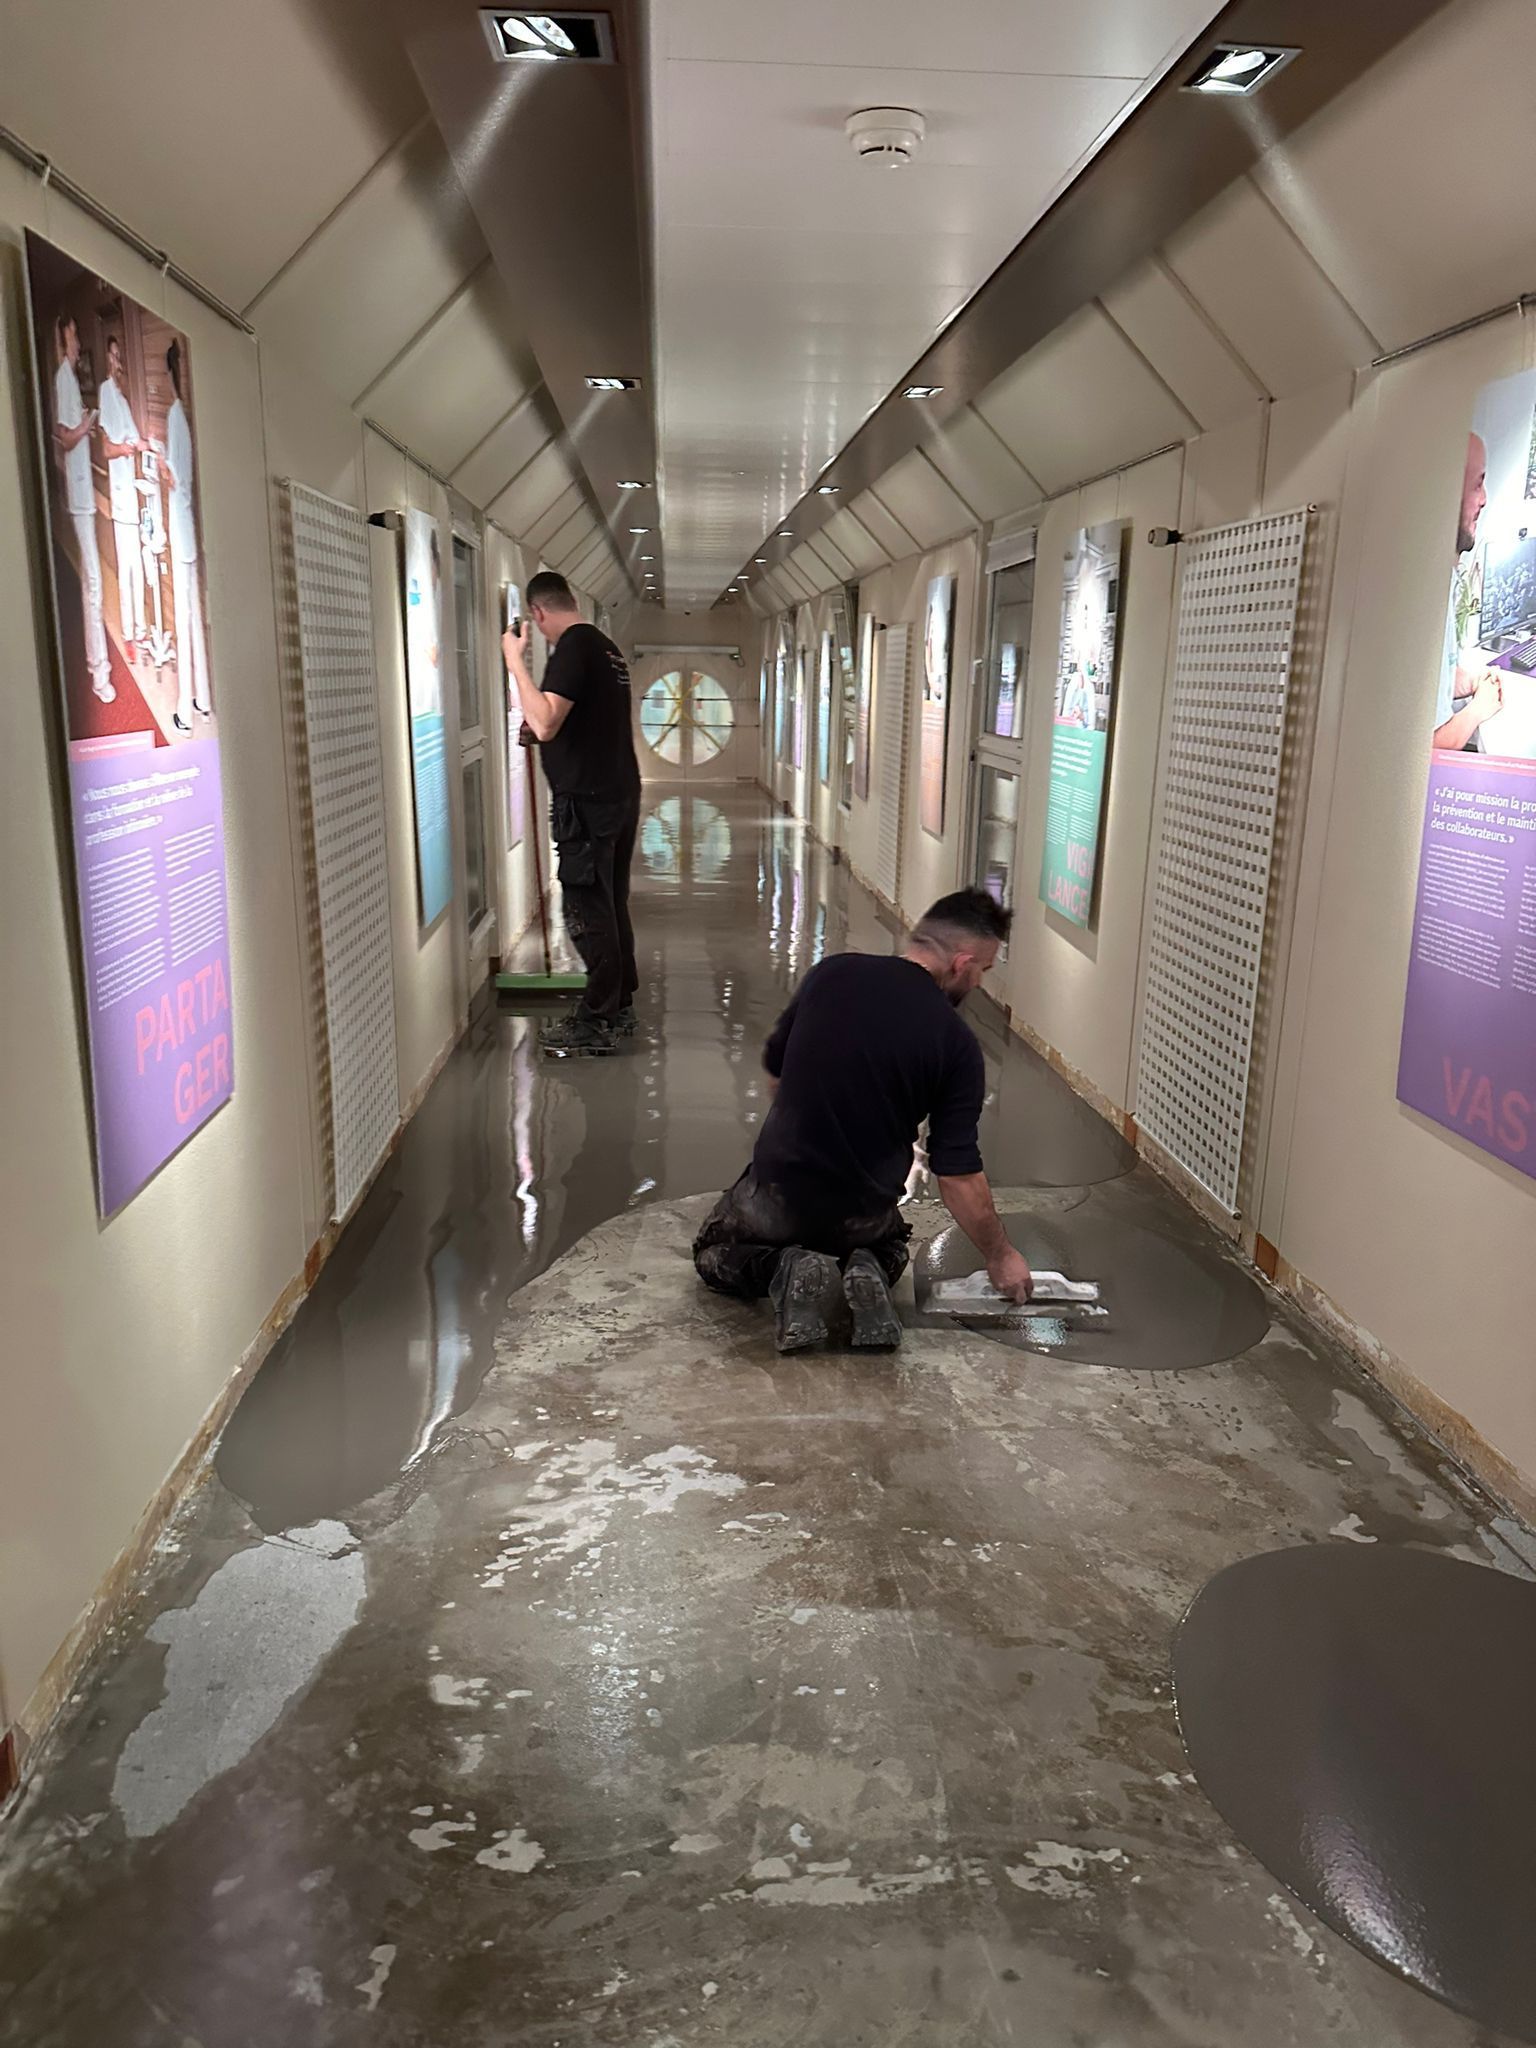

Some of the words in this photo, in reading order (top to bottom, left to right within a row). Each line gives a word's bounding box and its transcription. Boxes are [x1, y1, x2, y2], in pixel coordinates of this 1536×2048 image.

[1433, 801, 1440, 813] la
[1442, 803, 1484, 821] prévention
[1486, 812, 1496, 823] et
[1497, 812, 1505, 825] le
[1440, 786, 1455, 799] J'ai
[1455, 791, 1475, 802] pour
[1475, 792, 1509, 808] mission
[1511, 796, 1519, 809] la
[1431, 817, 1445, 830] des
[1446, 821, 1507, 843] collaborateurs.
[135, 958, 229, 1076] PARTA
[174, 1032, 229, 1125] GER
[1442, 1056, 1536, 1153] VAS
